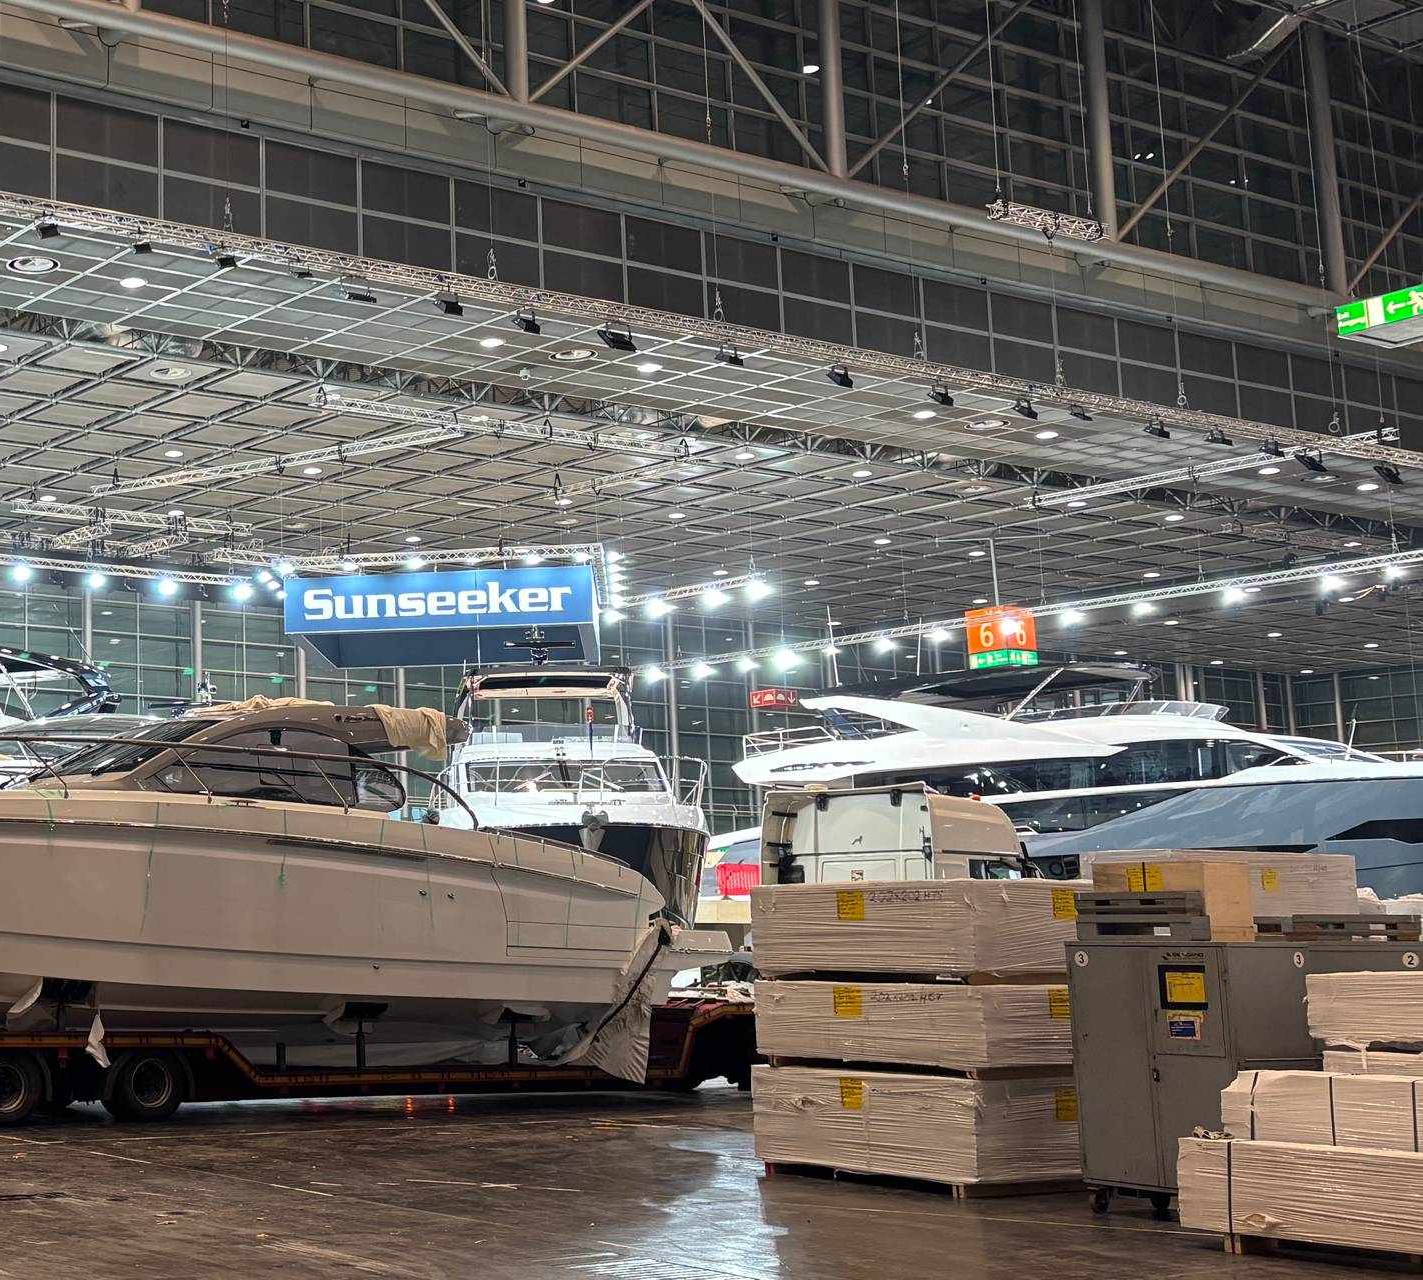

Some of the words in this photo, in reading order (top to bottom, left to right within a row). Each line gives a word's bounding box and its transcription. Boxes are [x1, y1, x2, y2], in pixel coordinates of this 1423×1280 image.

[303, 581, 573, 621] Sunseeker
[979, 622, 995, 648] 6
[1015, 620, 1027, 647] 6
